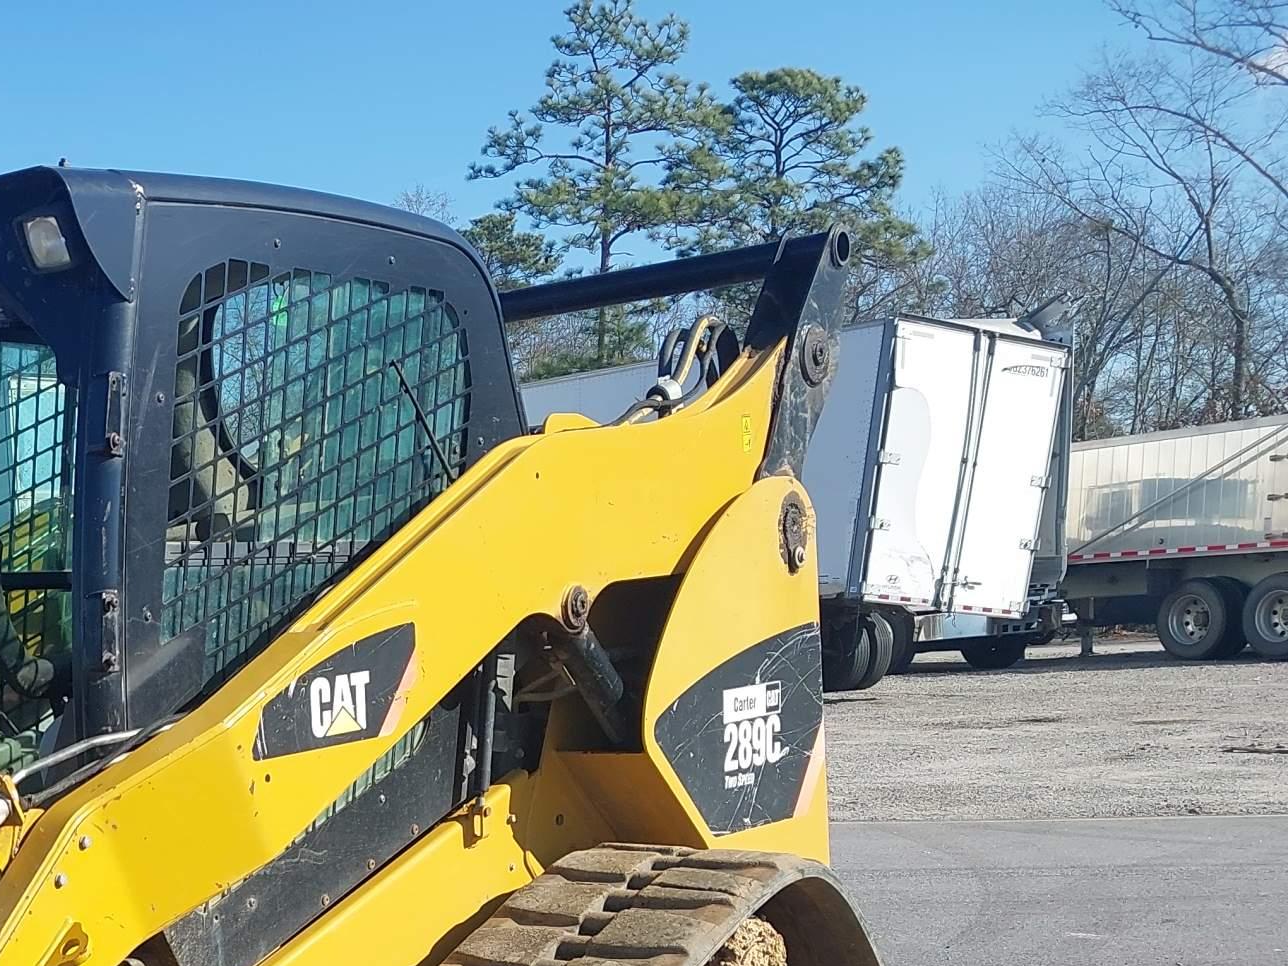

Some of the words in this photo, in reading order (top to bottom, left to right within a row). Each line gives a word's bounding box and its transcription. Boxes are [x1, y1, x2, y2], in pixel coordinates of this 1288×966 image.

[310, 670, 370, 738] CAT
[733, 696, 757, 712] Carter
[724, 714, 782, 772] 289C
